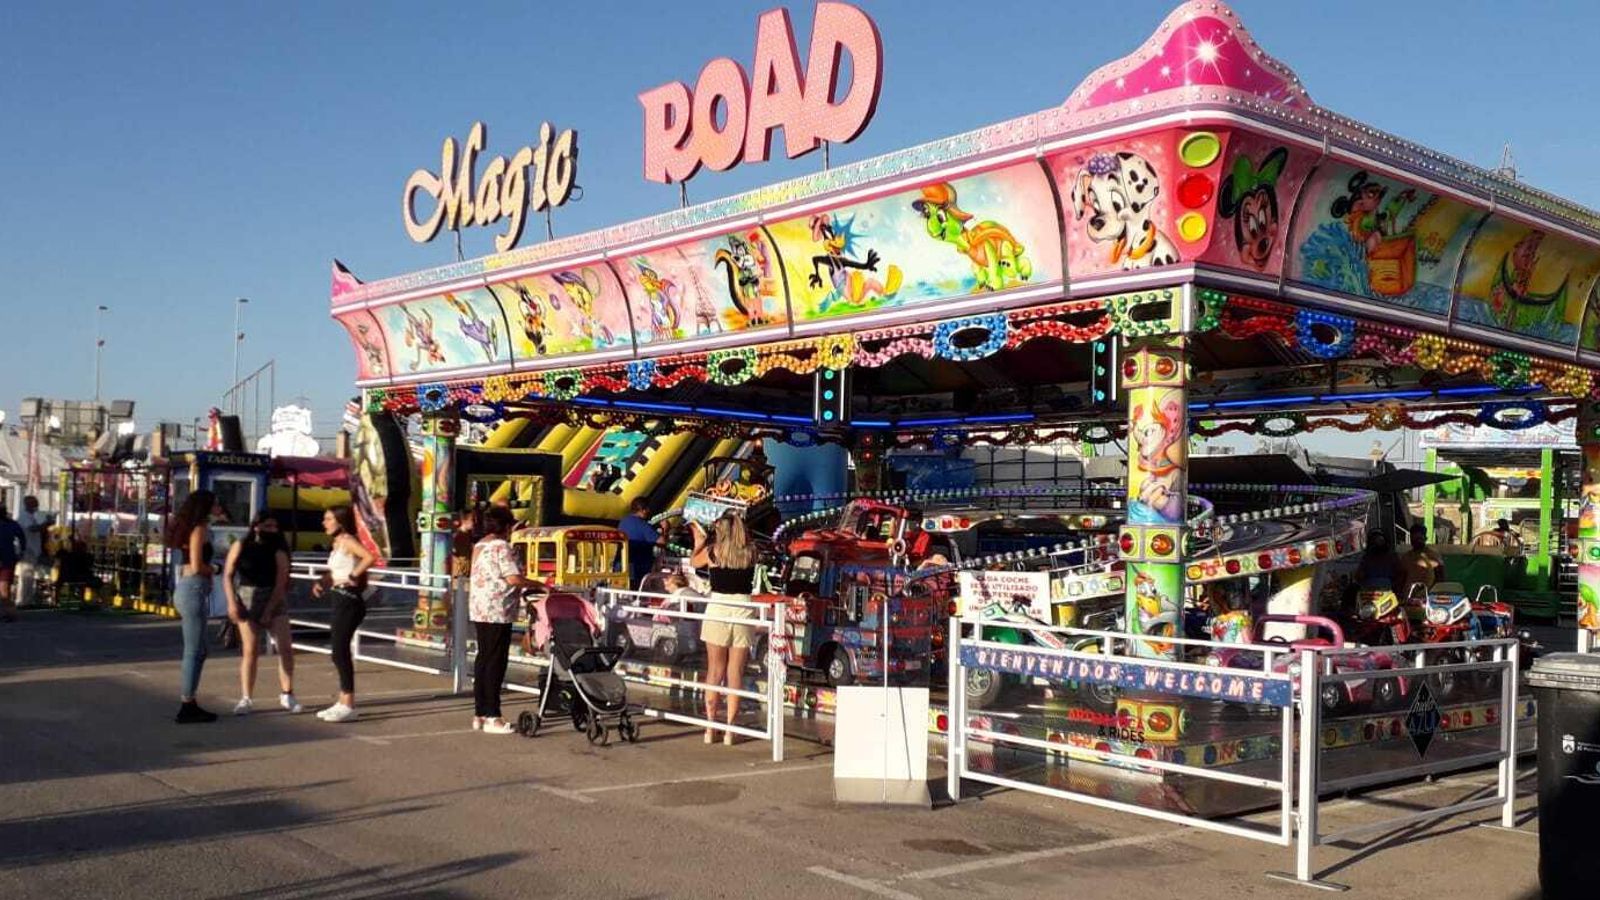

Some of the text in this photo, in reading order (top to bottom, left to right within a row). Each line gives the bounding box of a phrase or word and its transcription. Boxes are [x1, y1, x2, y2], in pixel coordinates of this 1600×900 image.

[637, 1, 883, 183] ROAD
[403, 121, 578, 251] Magic
[977, 650, 1119, 681] BIENVENIDOS
[1144, 668, 1264, 699] WELCOME
[1109, 726, 1145, 743] RIDES
